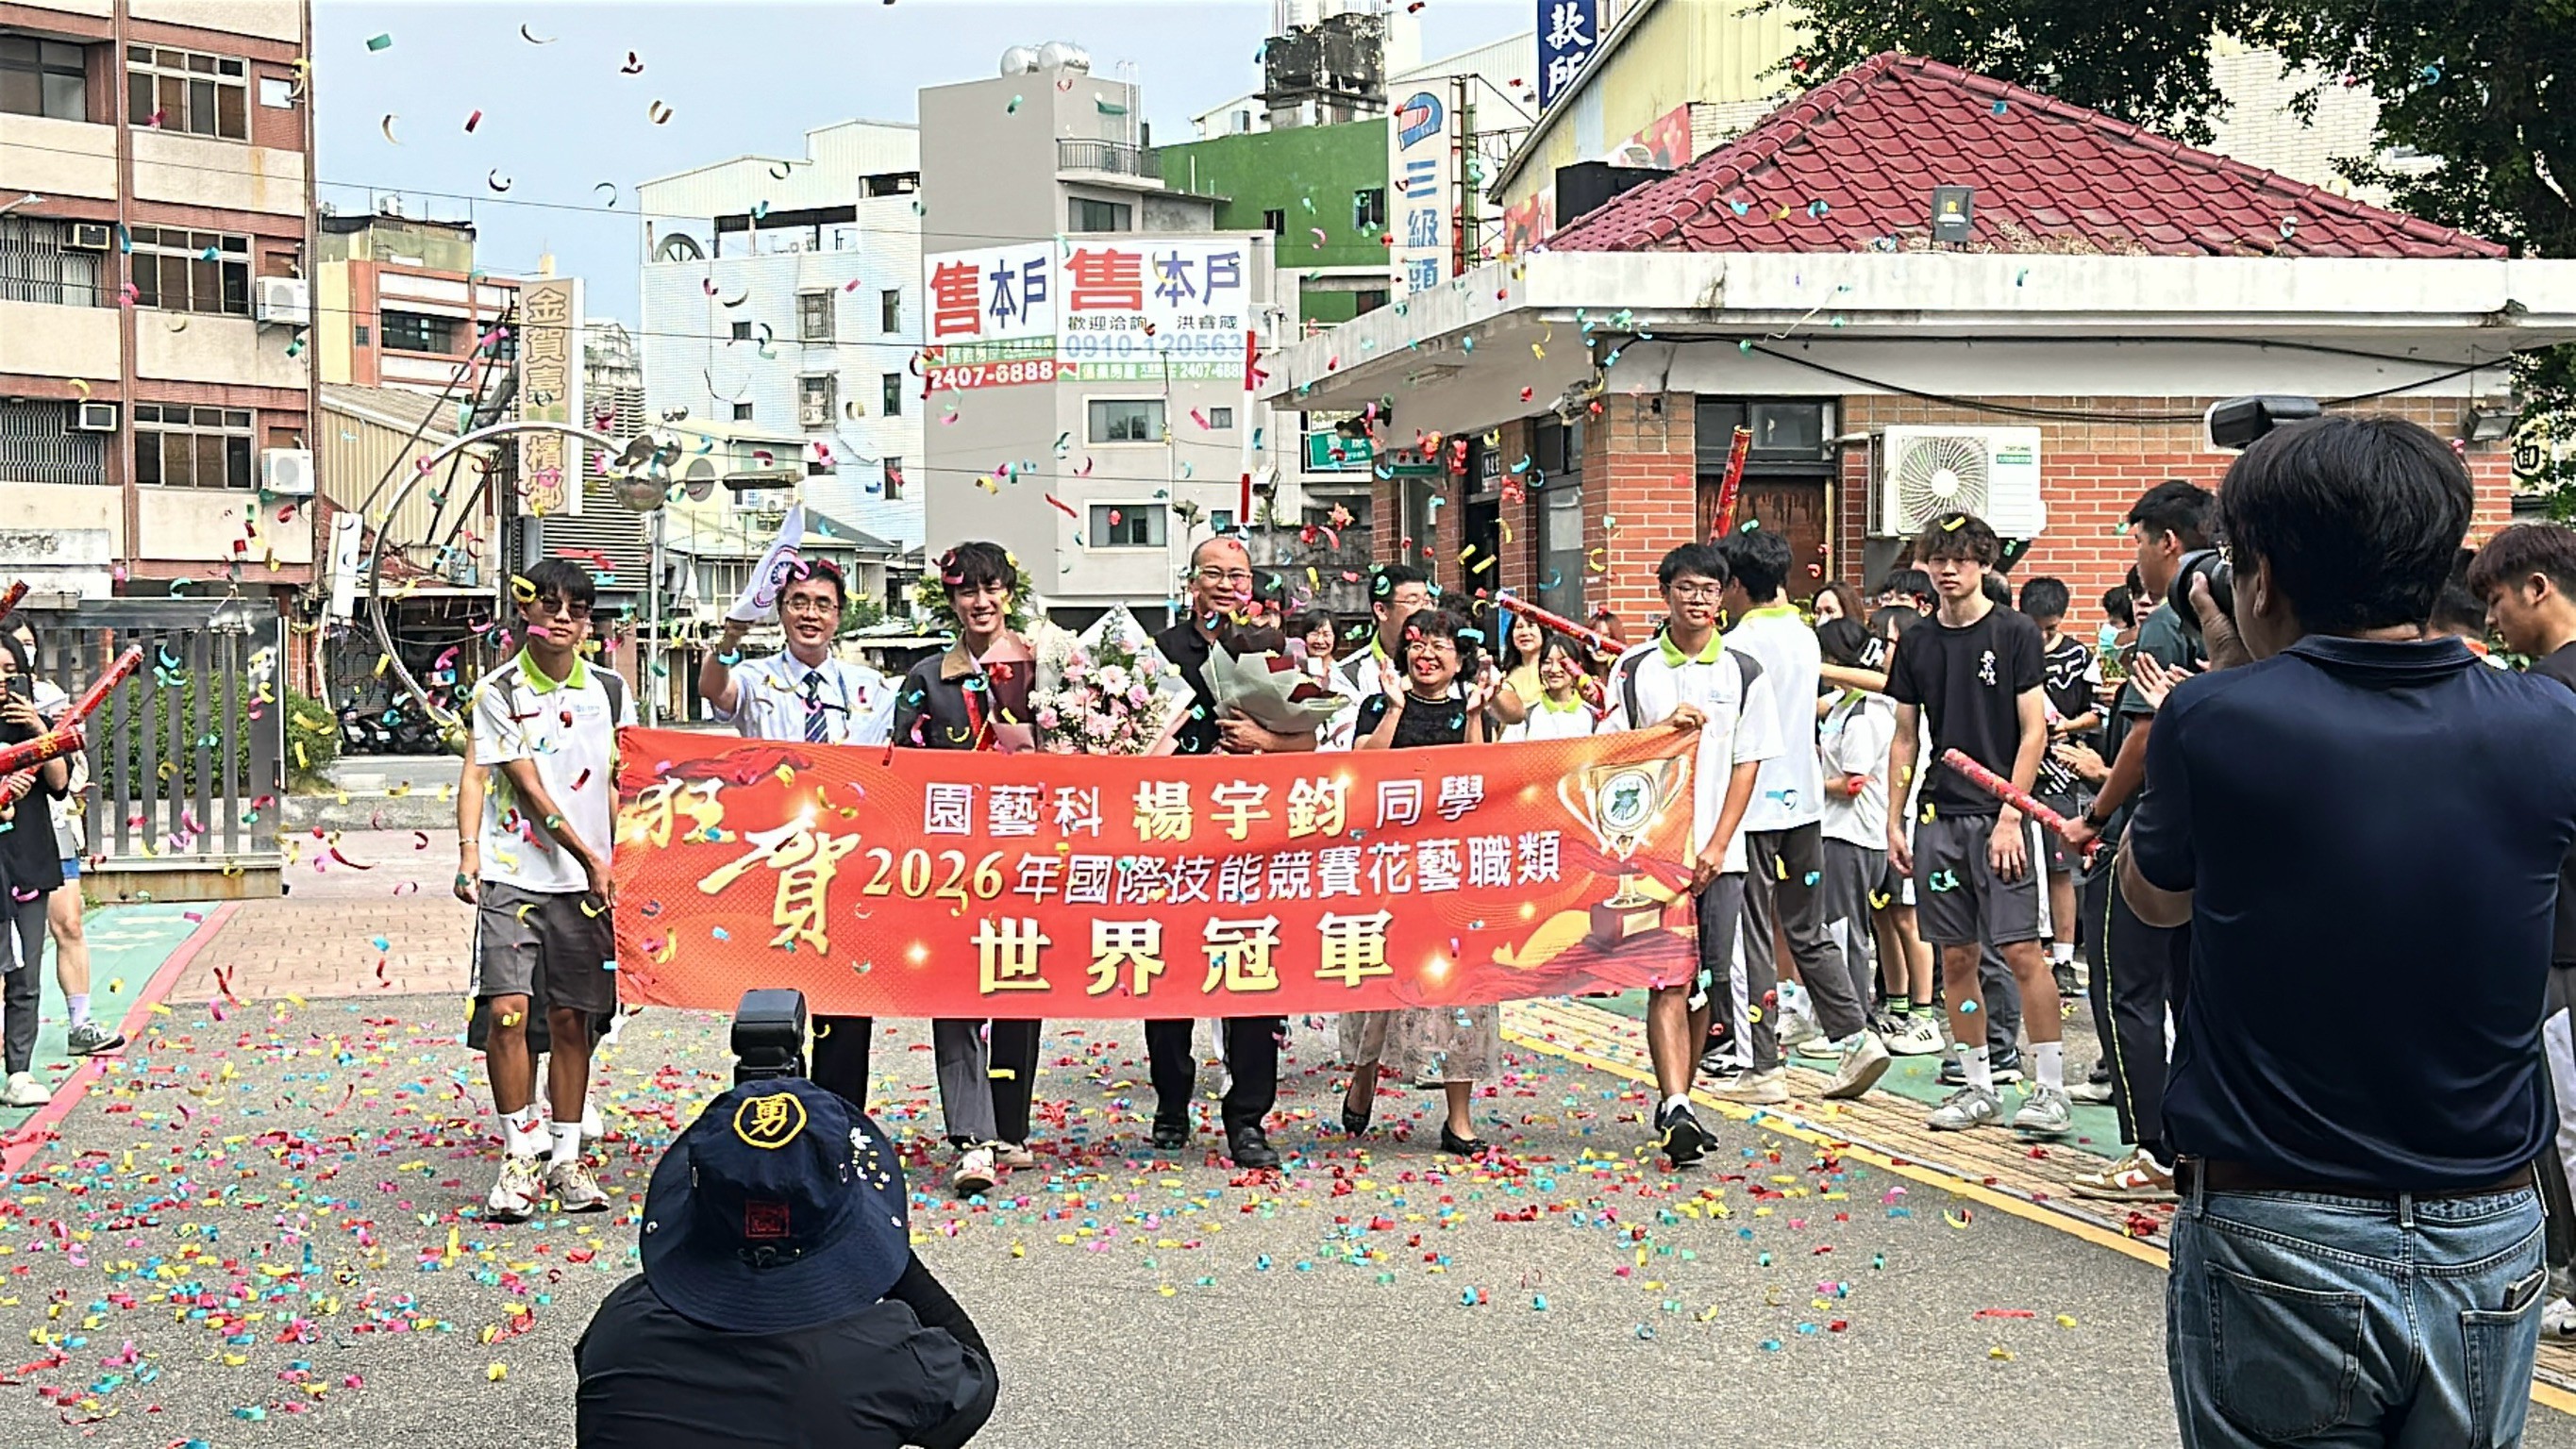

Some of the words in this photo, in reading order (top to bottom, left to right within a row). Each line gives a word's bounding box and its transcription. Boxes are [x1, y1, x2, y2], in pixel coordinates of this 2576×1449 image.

[929, 360, 1054, 390] 2407-6888
[1065, 332, 1243, 358] 0910-120563
[924, 782, 1103, 838] 園藝科
[1132, 776, 1349, 842] 楊宇鈞
[1375, 774, 1484, 829] 同學
[614, 775, 861, 956] 狂賀
[862, 830, 1562, 905] 2026年國際技能競賽花藝職類
[970, 908, 1394, 997] 世界冠軍
[748, 1096, 788, 1137] 勇
